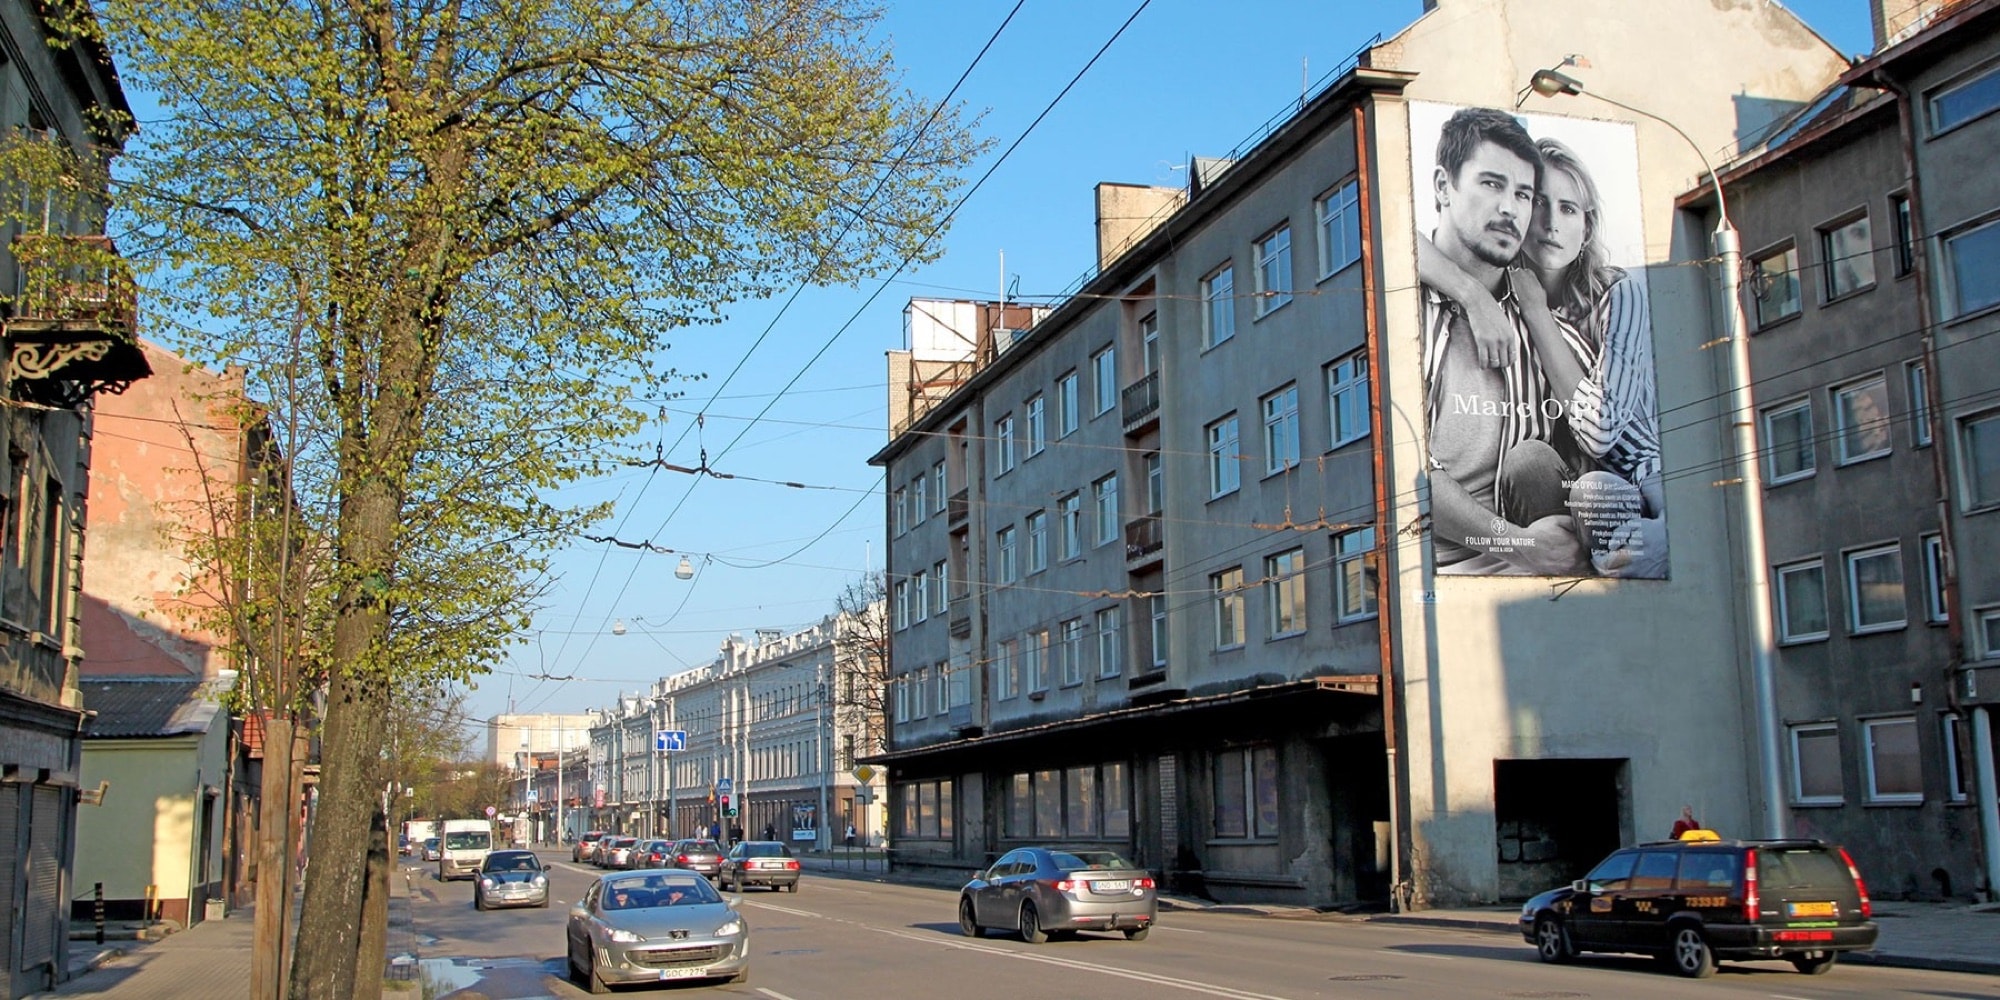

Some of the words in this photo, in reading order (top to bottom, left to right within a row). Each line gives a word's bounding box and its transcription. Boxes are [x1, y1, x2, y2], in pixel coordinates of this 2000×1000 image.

[1452, 393, 1532, 418] Marc
[1541, 398, 1634, 422] O'Polo
[1465, 536, 1491, 546] FOLLOW
[1492, 537, 1510, 546] YOUR
[1511, 537, 1535, 547] NATURE
